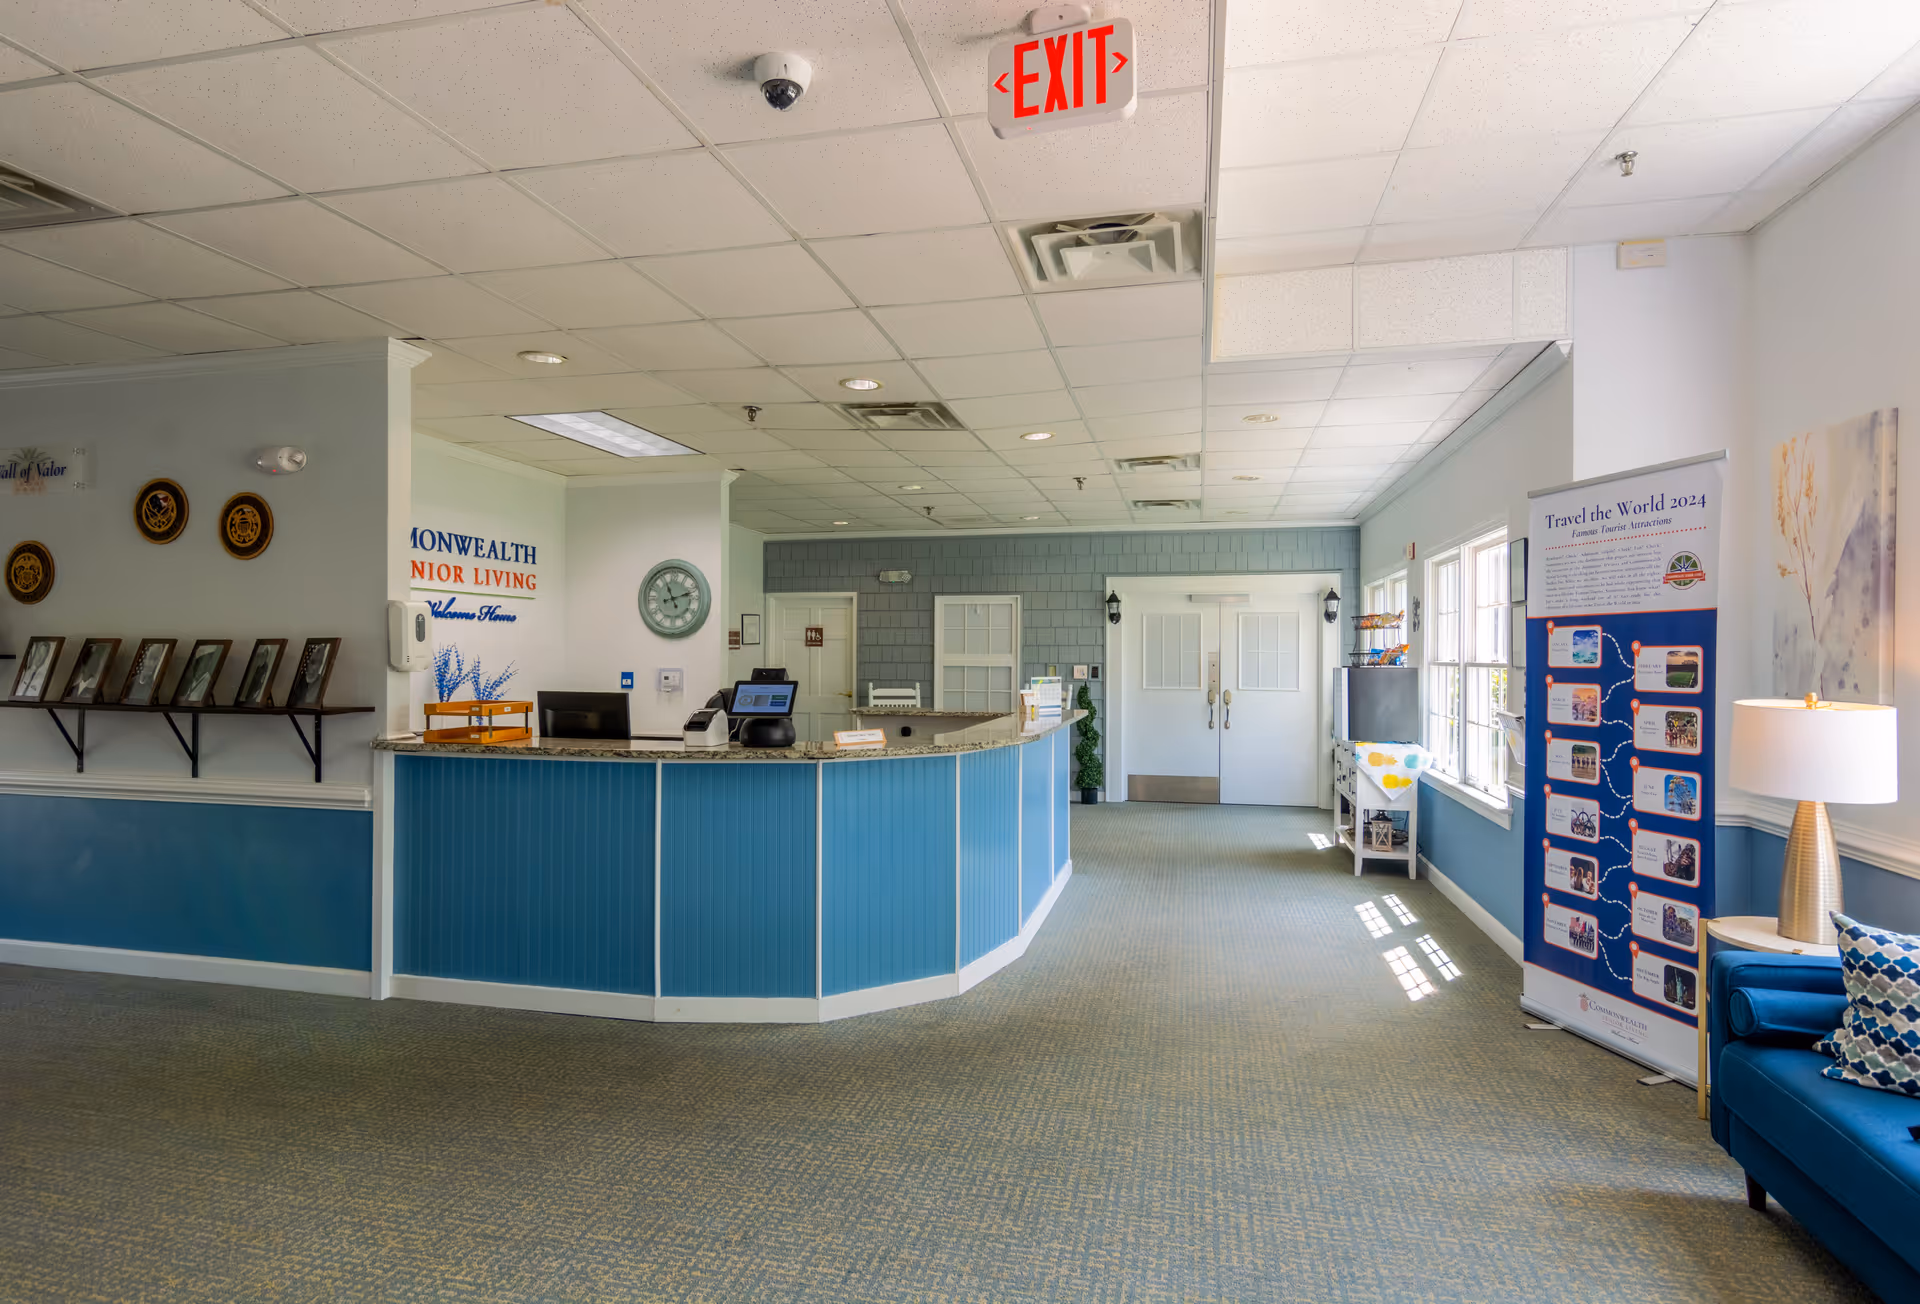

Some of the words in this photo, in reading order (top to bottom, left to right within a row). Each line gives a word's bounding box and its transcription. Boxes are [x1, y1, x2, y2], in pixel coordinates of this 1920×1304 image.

[1013, 24, 1114, 119] EXIT
[20, 461, 34, 483] of
[37, 460, 67, 478] Valor
[1545, 507, 1586, 529] Travel
[1590, 504, 1612, 521] the
[1616, 493, 1665, 516] World
[1670, 493, 1707, 510] 2024
[1571, 527, 1598, 539] Famous
[1601, 523, 1627, 535] Tourist
[1628, 516, 1673, 531] Attractions
[410, 560, 465, 584] NIOR
[473, 567, 537, 591] LIVING
[424, 597, 476, 621] Welcome
[477, 605, 517, 623] Home
